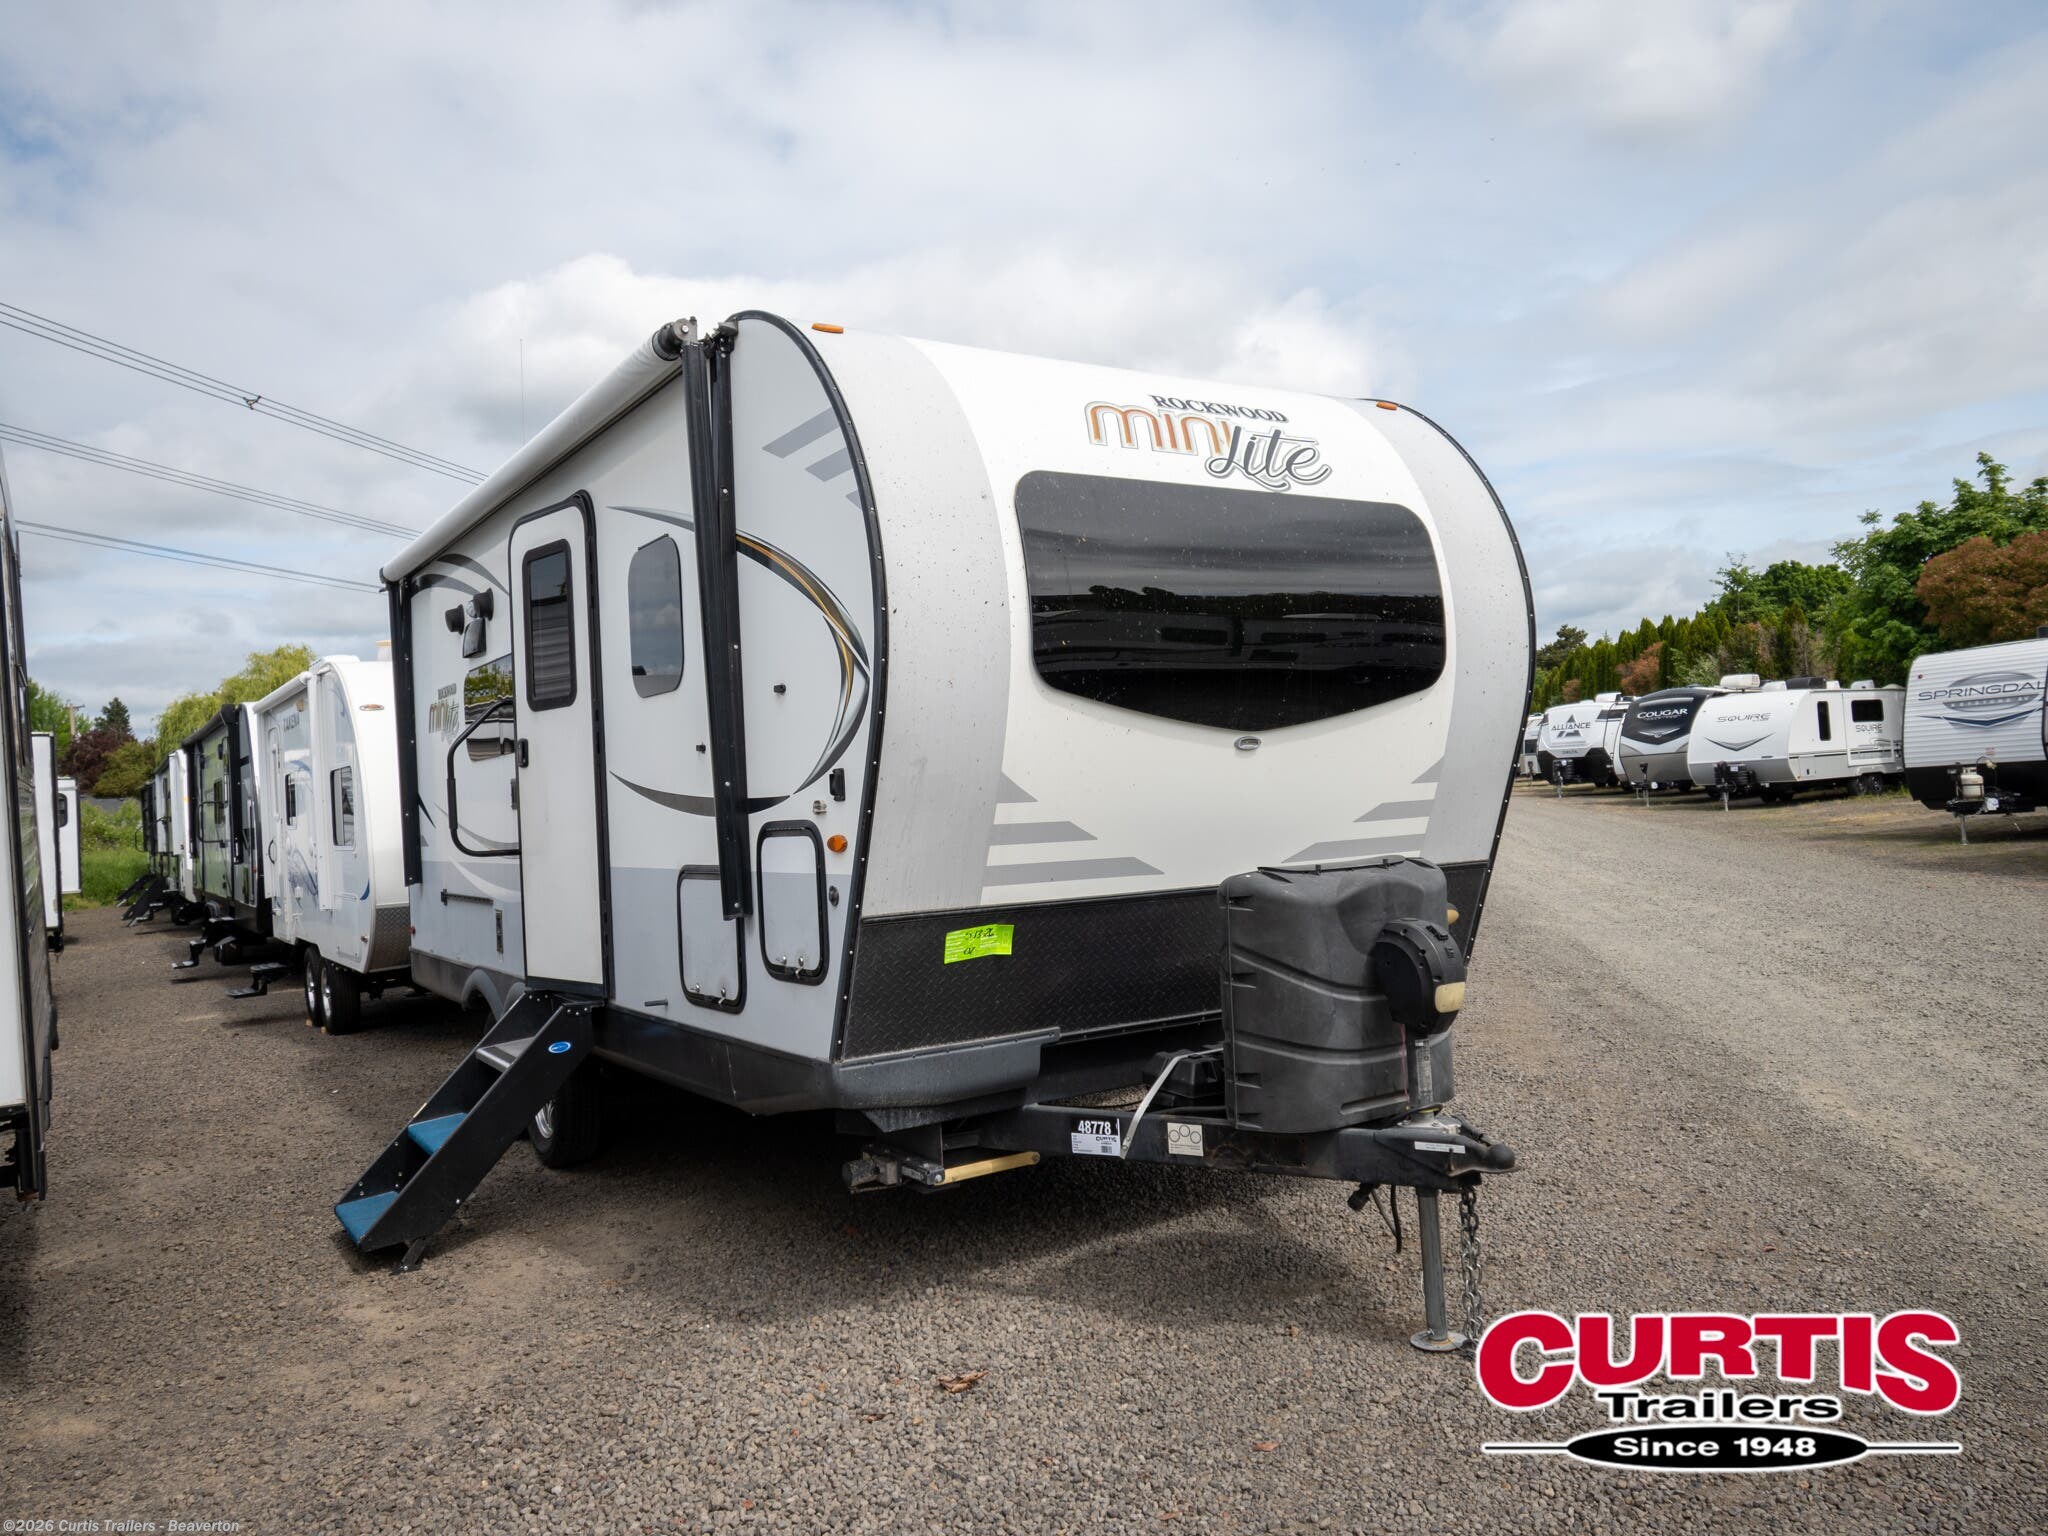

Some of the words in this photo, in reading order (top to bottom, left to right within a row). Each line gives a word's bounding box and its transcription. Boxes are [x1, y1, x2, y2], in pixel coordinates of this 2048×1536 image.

[1150, 394, 1288, 422] ROCKWOOD
[1086, 401, 1232, 456] mini
[1207, 425, 1330, 489] Lite
[1637, 708, 1688, 719] COUGAR
[1716, 712, 1771, 722] SQUIRE
[1551, 721, 1591, 731] ALLIANCE
[1078, 1120, 1112, 1135] 48778
